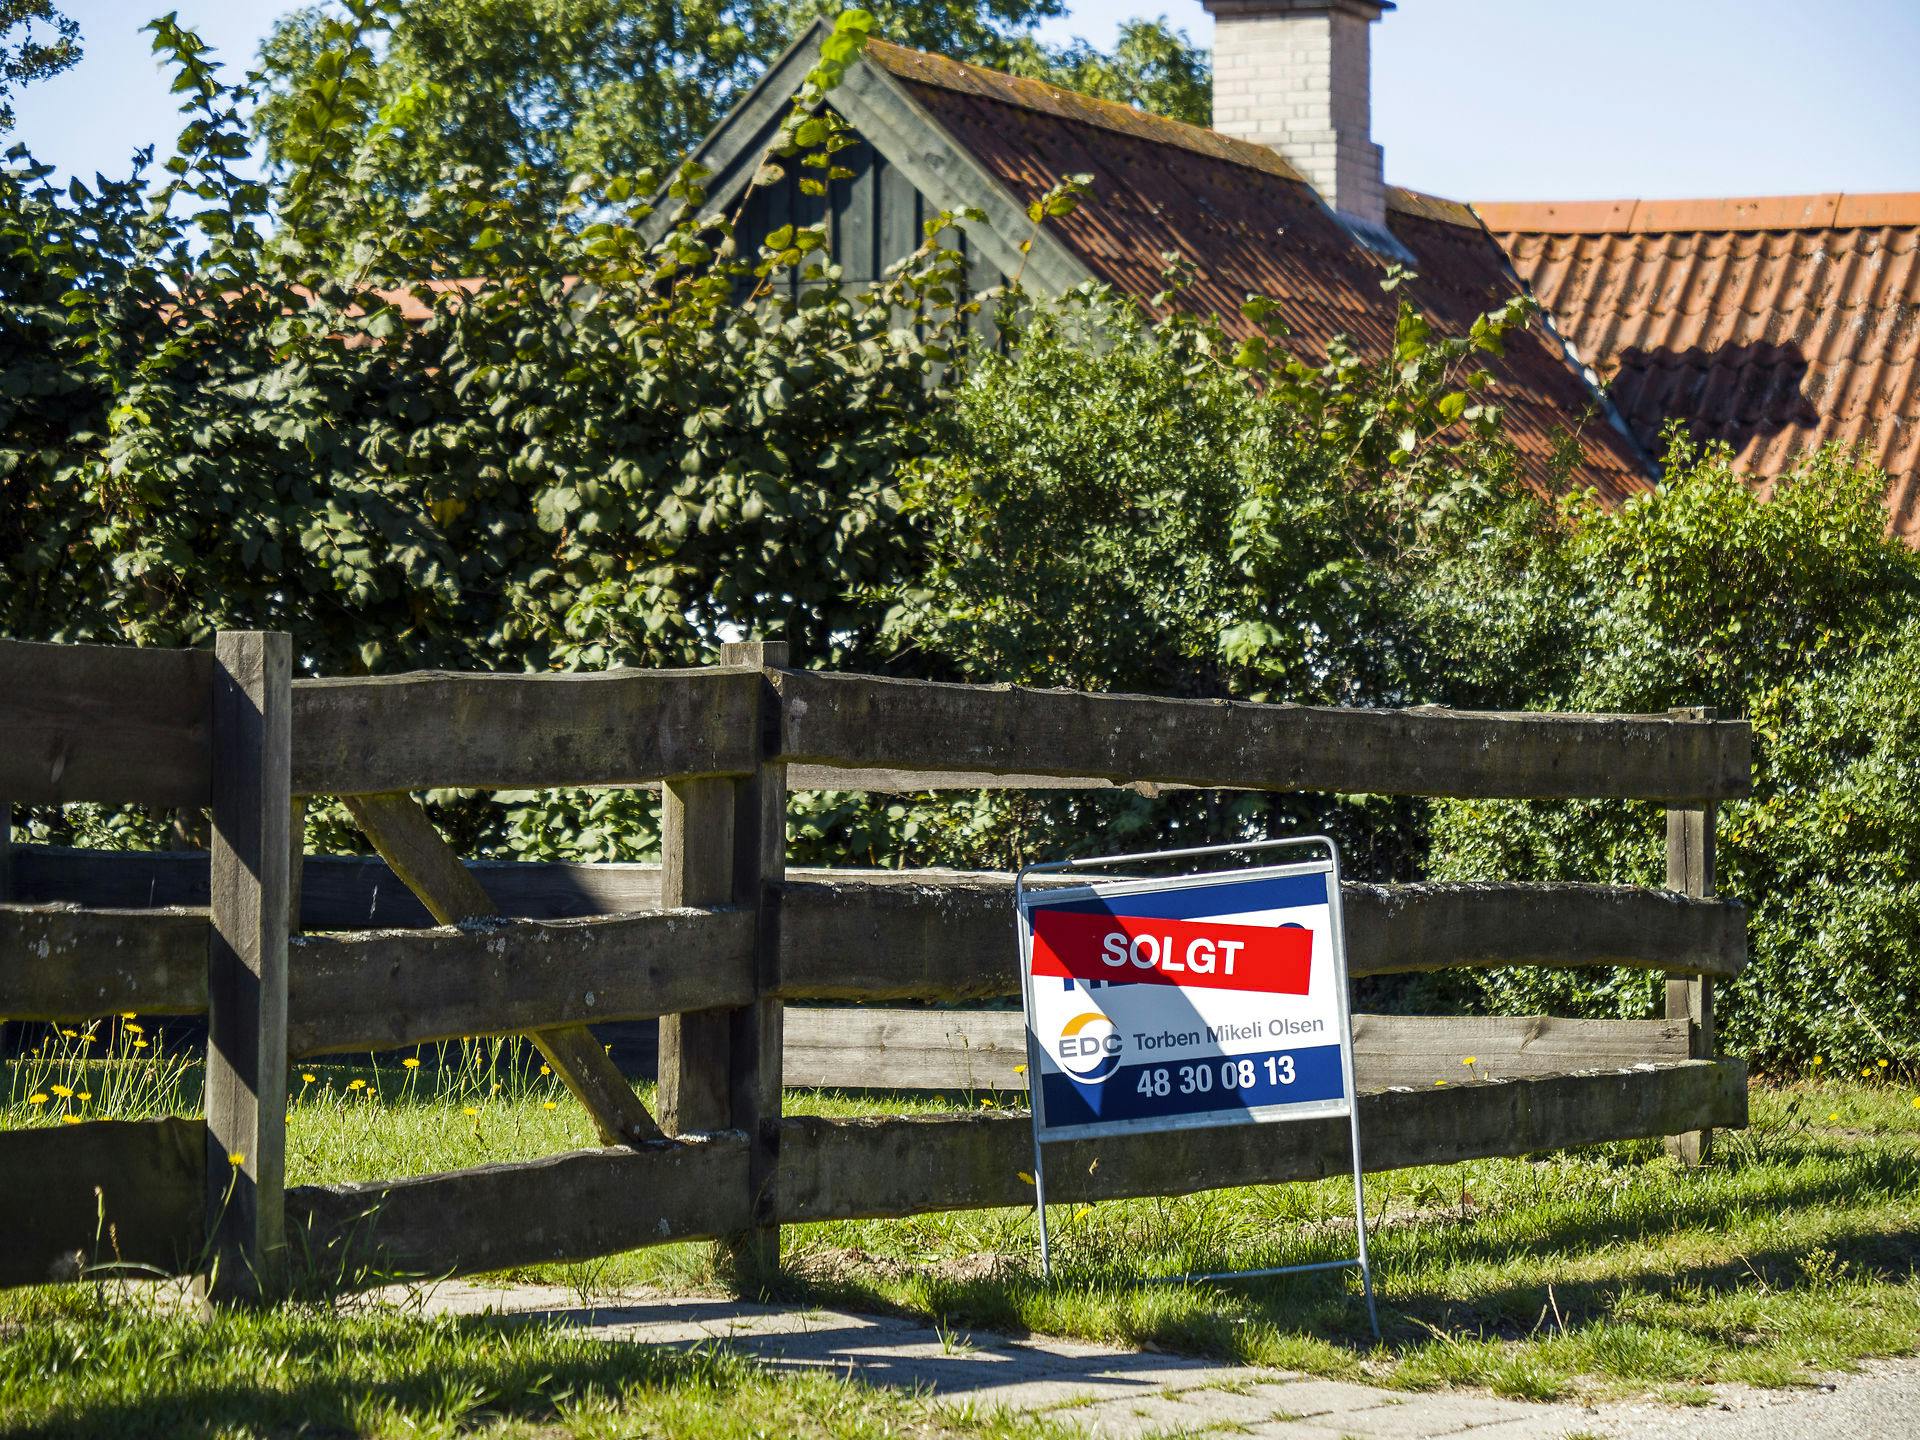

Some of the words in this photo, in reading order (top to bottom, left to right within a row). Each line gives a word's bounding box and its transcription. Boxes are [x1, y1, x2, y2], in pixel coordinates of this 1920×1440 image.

[1101, 932, 1245, 976] SOLGT
[1059, 1034, 1123, 1059] EDC
[1133, 1031, 1200, 1051] Torben
[1206, 1020, 1262, 1044] Mikeli
[1268, 1017, 1324, 1037] Olsen
[1137, 1068, 1171, 1098] 48
[1179, 1064, 1213, 1095] 30
[1222, 1059, 1256, 1091] 08
[1263, 1055, 1296, 1086] 13
